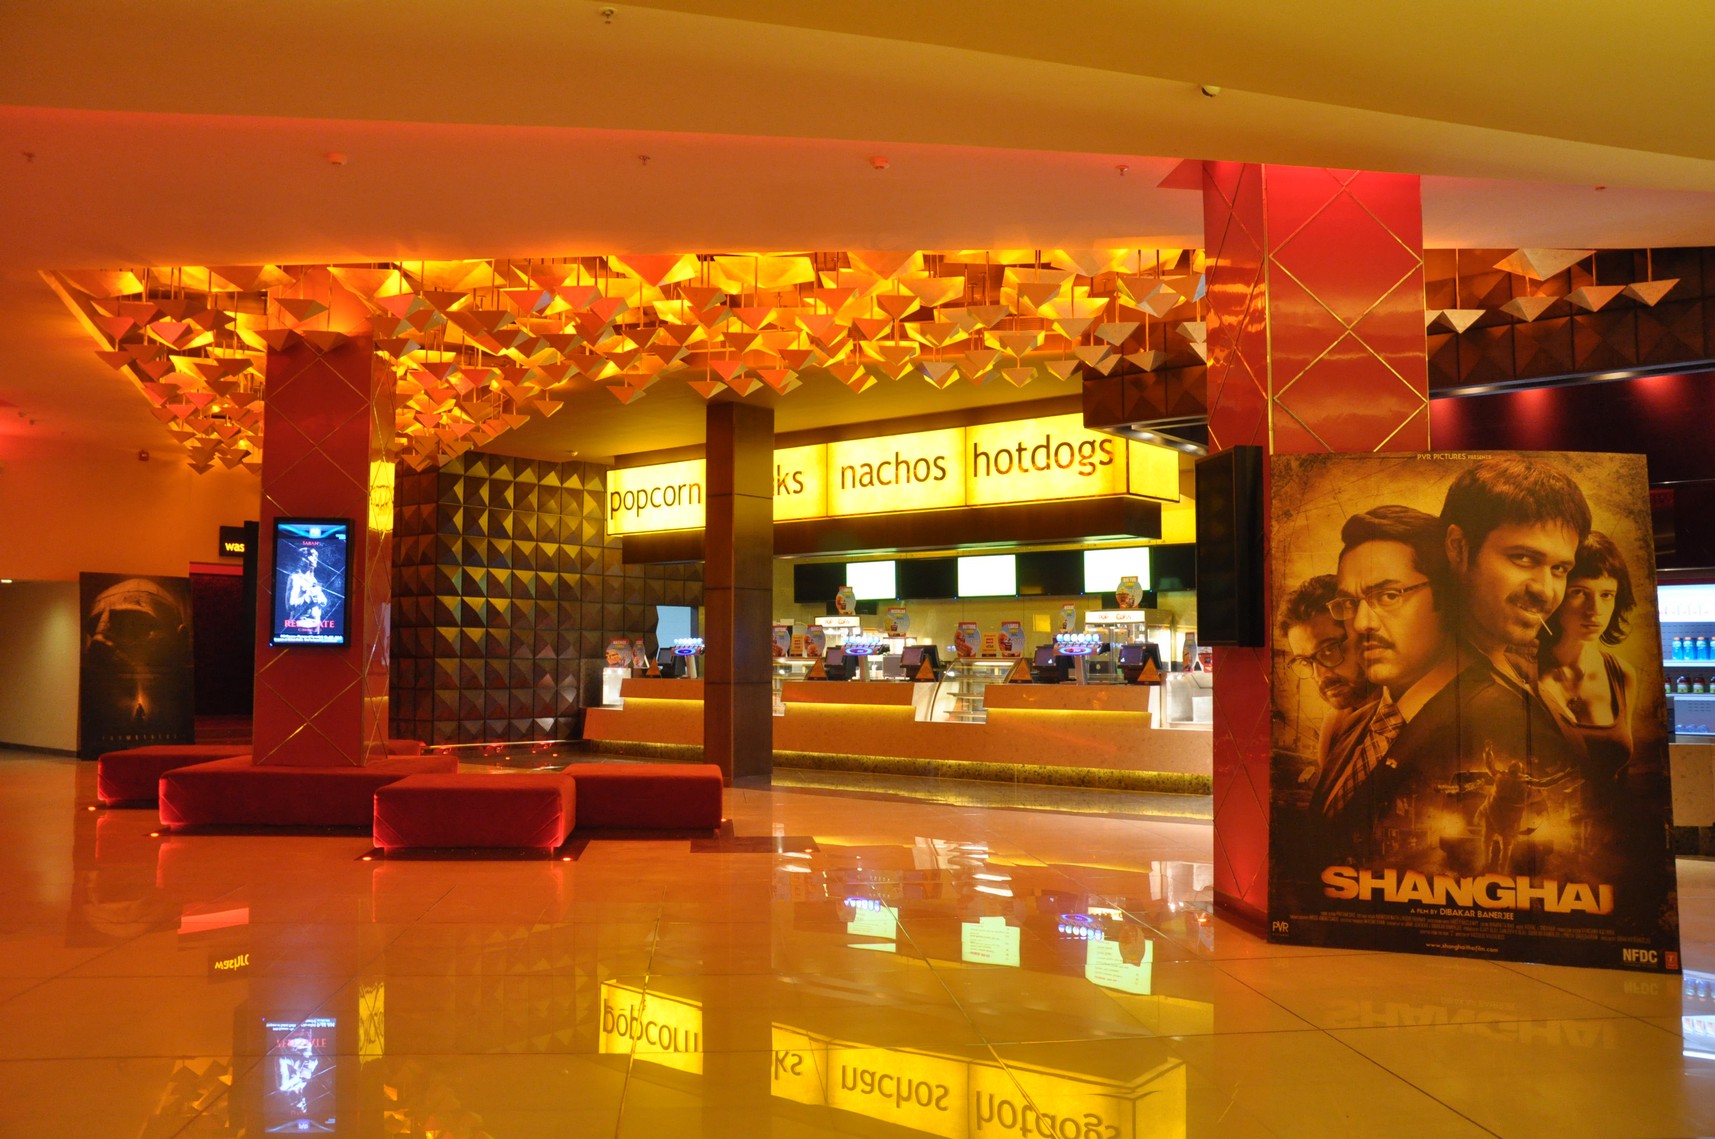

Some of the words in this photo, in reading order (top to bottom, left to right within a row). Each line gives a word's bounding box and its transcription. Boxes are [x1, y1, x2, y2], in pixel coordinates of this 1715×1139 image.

[610, 482, 701, 520] popcorn
[841, 452, 946, 490] nachos
[973, 434, 1114, 477] hotdogs
[225, 542, 245, 552] was
[1320, 866, 1615, 915] SHANGHAI
[1440, 908, 1475, 917] DIBAKAR
[1477, 910, 1514, 920] BANERJEE
[1272, 921, 1289, 933] PVR
[1622, 948, 1658, 963] NFDC
